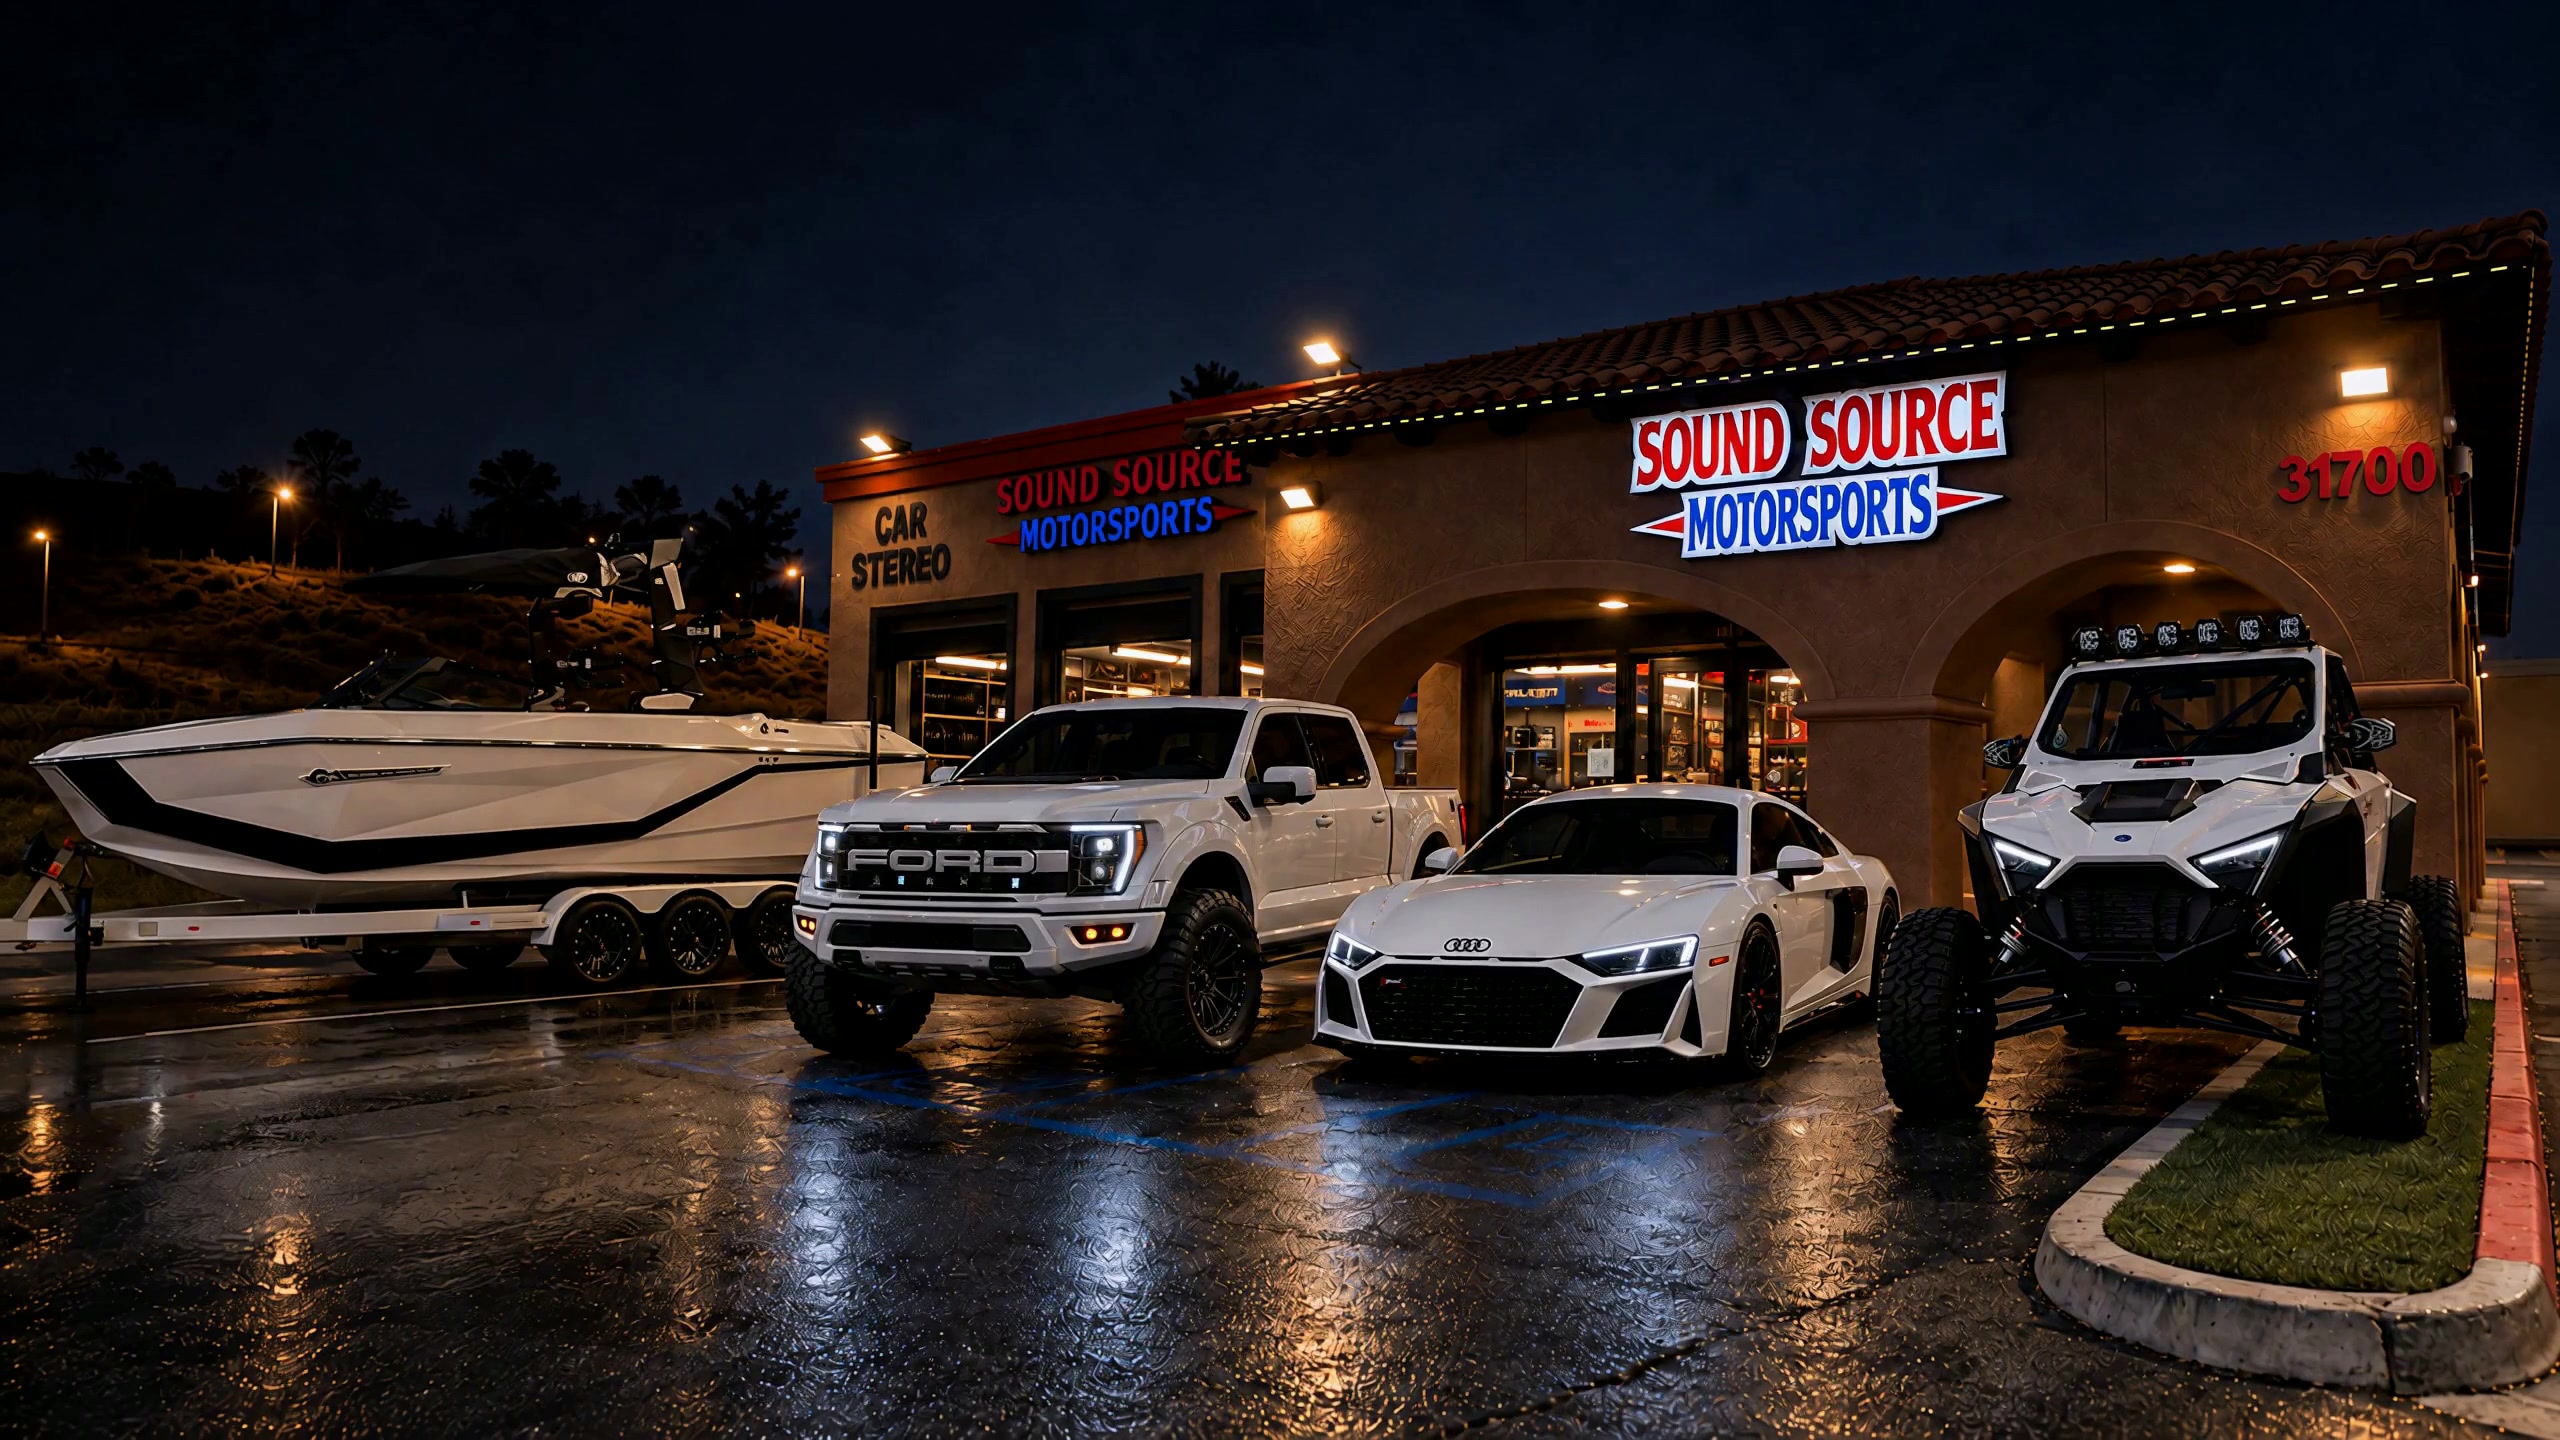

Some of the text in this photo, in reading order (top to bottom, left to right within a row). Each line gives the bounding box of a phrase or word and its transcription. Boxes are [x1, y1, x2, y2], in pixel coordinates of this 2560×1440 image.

[1637, 378, 1999, 486] SOUND SOURCE
[997, 449, 1242, 514] SOUND SOURCE
[2278, 441, 2436, 503] 31700
[875, 502, 928, 546] CAR
[1020, 496, 1213, 552] MOTORSPORTS
[1687, 473, 1932, 552] MOTORSPORTS
[852, 543, 951, 592] STEREO
[848, 848, 1036, 874] FORD
